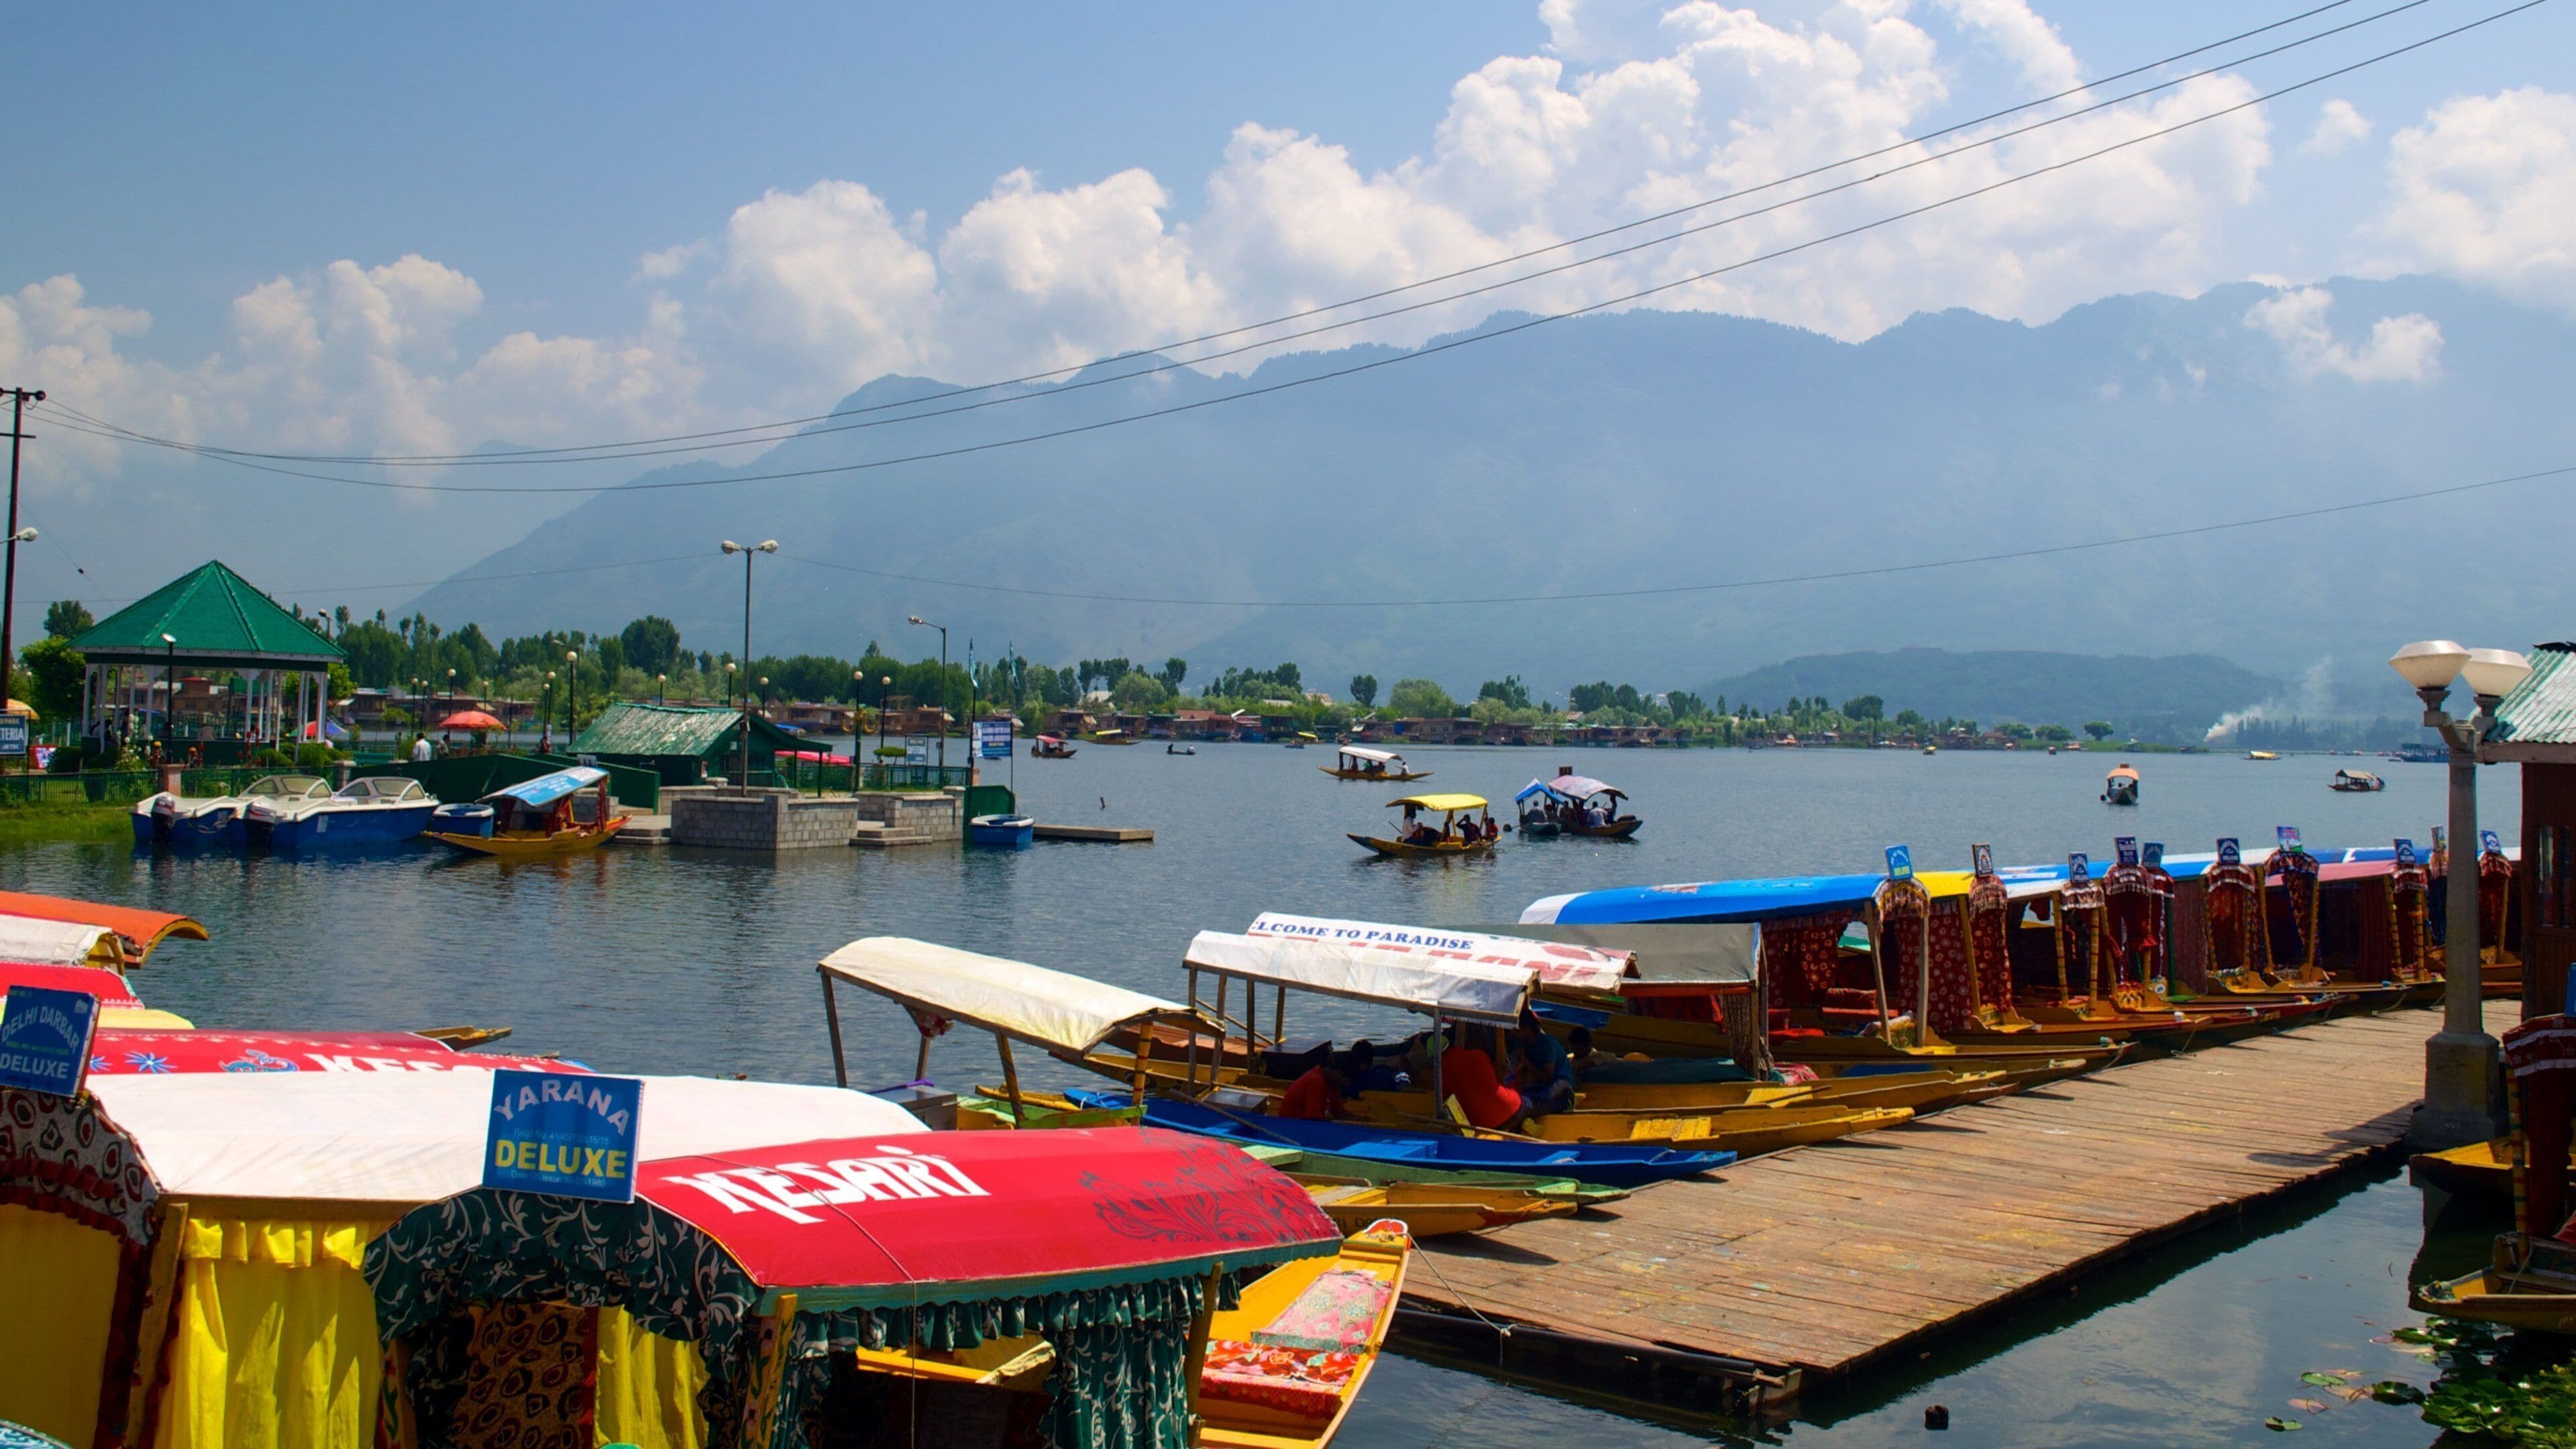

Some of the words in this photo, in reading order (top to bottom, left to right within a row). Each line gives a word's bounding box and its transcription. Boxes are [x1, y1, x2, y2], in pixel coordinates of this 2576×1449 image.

[0, 728, 24, 741] TERIA
[1335, 929, 1360, 938] TO
[1365, 931, 1473, 950] PARADISE
[2, 1007, 38, 1042] DELHI
[39, 1006, 80, 1054] DARBAR
[0, 1053, 70, 1079] DELUXE
[494, 1079, 630, 1136] YARANA
[495, 1140, 627, 1179] DELUXE
